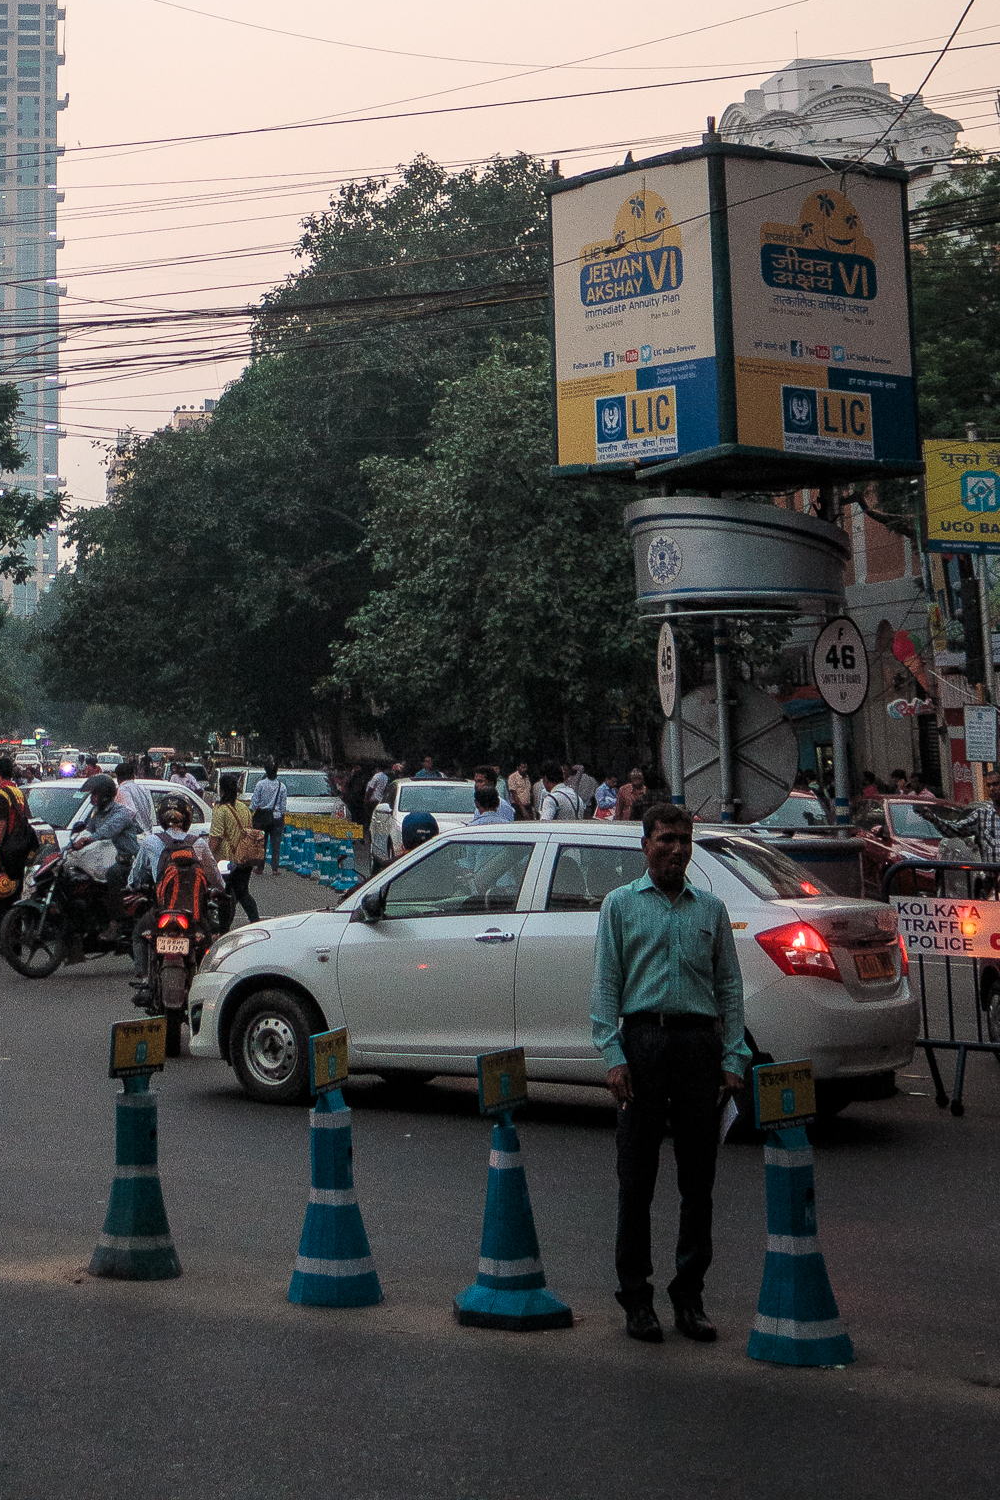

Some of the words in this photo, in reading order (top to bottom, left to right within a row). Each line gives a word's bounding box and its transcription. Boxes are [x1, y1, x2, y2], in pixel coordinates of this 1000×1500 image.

[586, 256, 643, 285] JEEVAN
[645, 251, 677, 290] VI
[770, 247, 834, 276] जीवन
[586, 277, 643, 304] AKSHAY
[772, 270, 834, 291] अक्षय
[838, 261, 869, 297] VI
[585, 303, 627, 319] Immediate
[629, 298, 660, 312] Annuity
[662, 293, 680, 304] Plan
[653, 348, 661, 357] LIC
[663, 347, 675, 355] India
[677, 344, 696, 354] Forever
[631, 394, 669, 435] LIC
[824, 396, 865, 436] LIC
[939, 449, 981, 469] यूको
[941, 521, 974, 533] UCO
[661, 646, 672, 672] 46
[826, 644, 855, 669] 46
[897, 901, 981, 919] KOLKATA
[902, 919, 977, 936] TRAFFIC
[908, 935, 974, 952] POLICE
